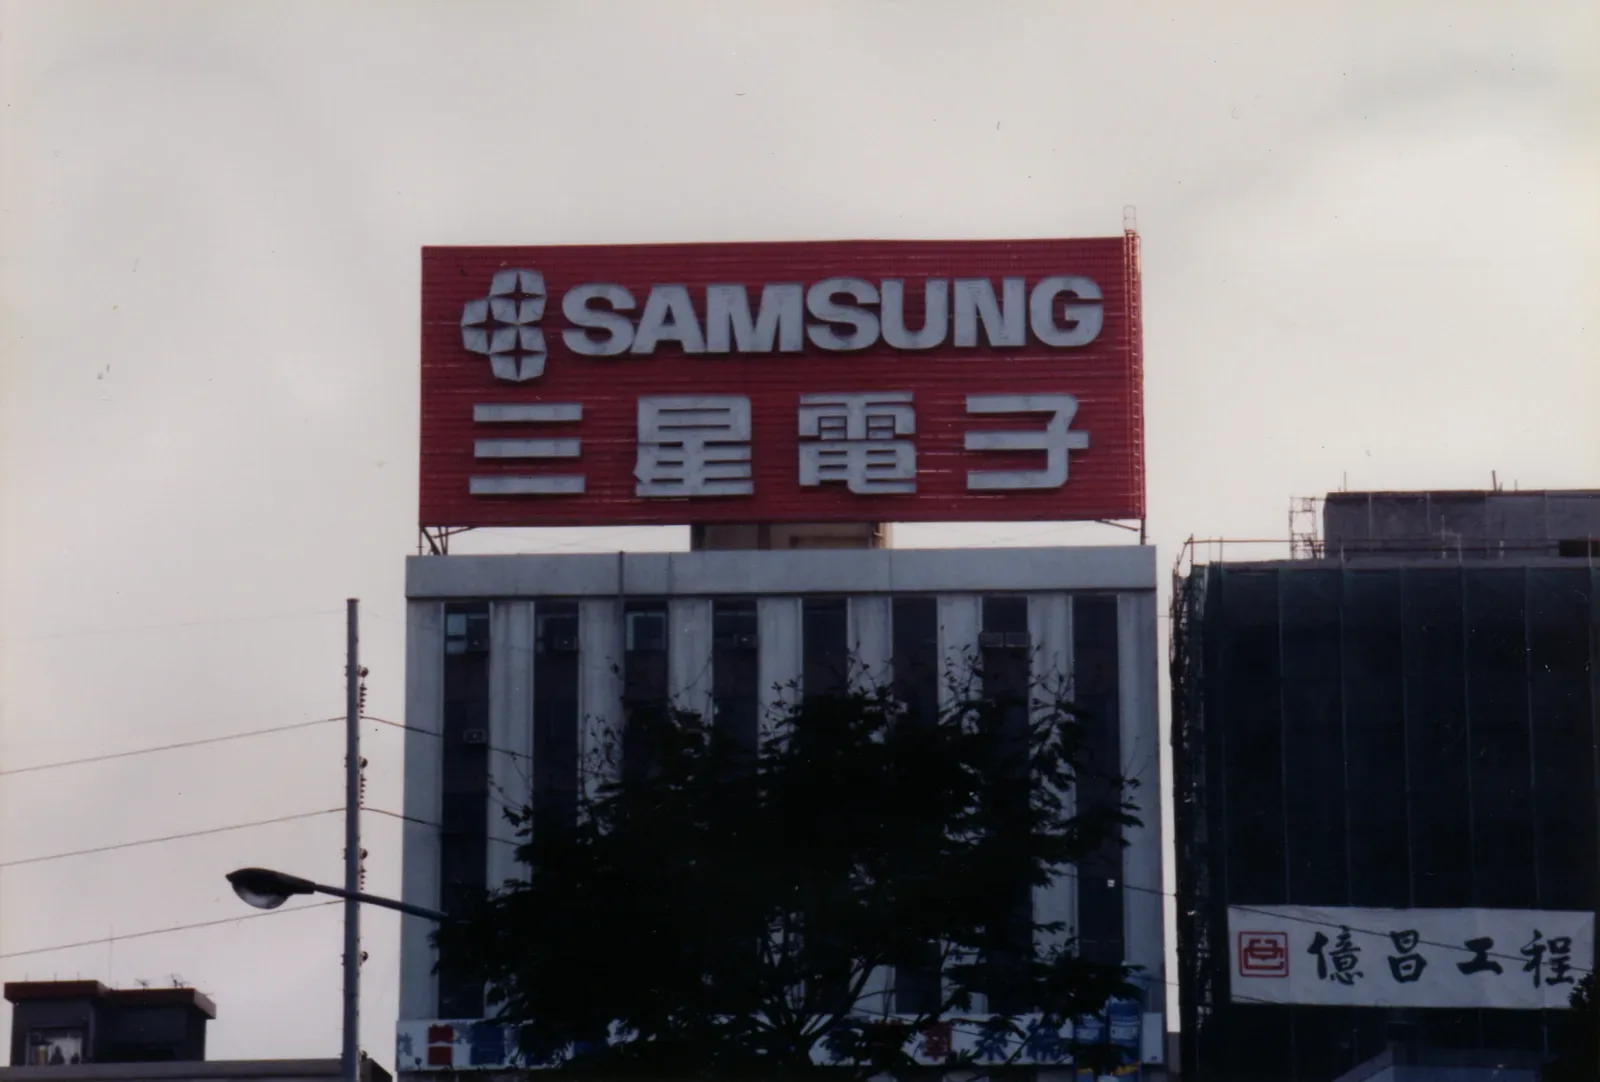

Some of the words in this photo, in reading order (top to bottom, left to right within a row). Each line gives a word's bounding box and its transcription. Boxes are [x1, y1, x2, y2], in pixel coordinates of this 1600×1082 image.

[561, 275, 1104, 356] SAMSUNG
[469, 393, 1090, 498] 三星電子
[1307, 926, 1576, 988] 億昌工程
